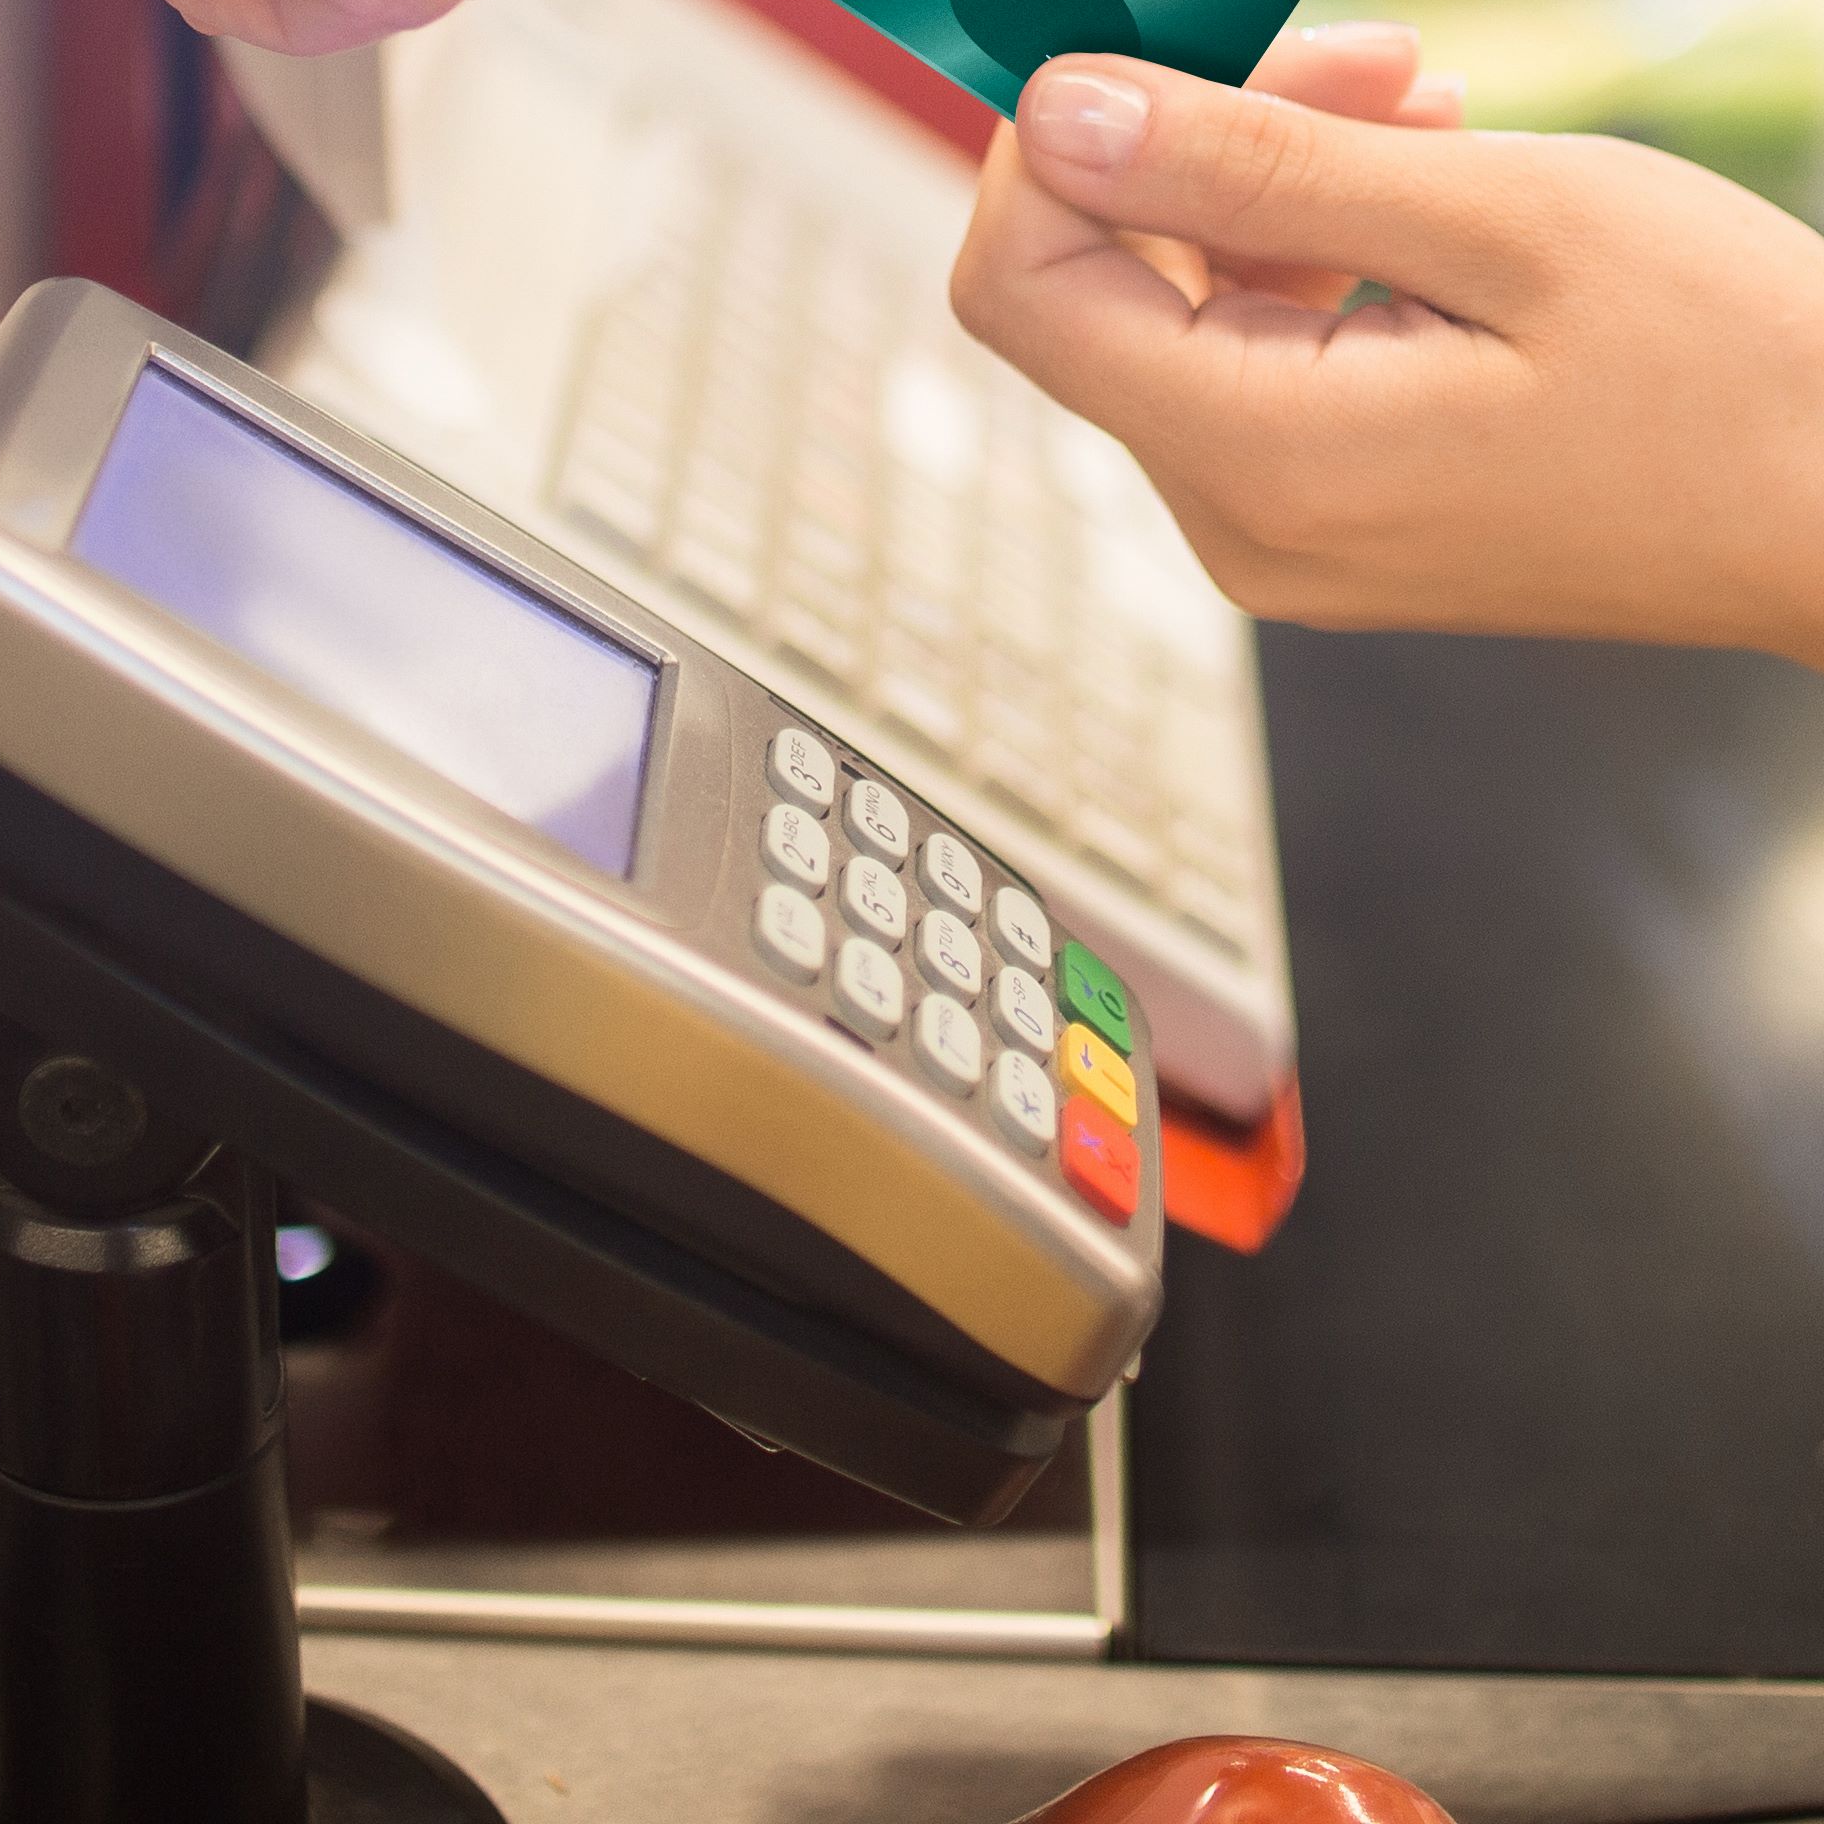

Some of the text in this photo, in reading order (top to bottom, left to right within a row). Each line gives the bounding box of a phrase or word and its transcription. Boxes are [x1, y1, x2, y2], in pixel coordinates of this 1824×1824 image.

[790, 737, 822, 792] 3 DEF
[782, 811, 800, 843] ABC
[865, 785, 896, 842] 6 MNO
[782, 842, 815, 871] 2
[862, 870, 878, 897] JKL
[941, 871, 970, 899] 9
[862, 894, 894, 923] 5
[939, 919, 970, 979] 8 TUV
[1009, 920, 1040, 954] #
